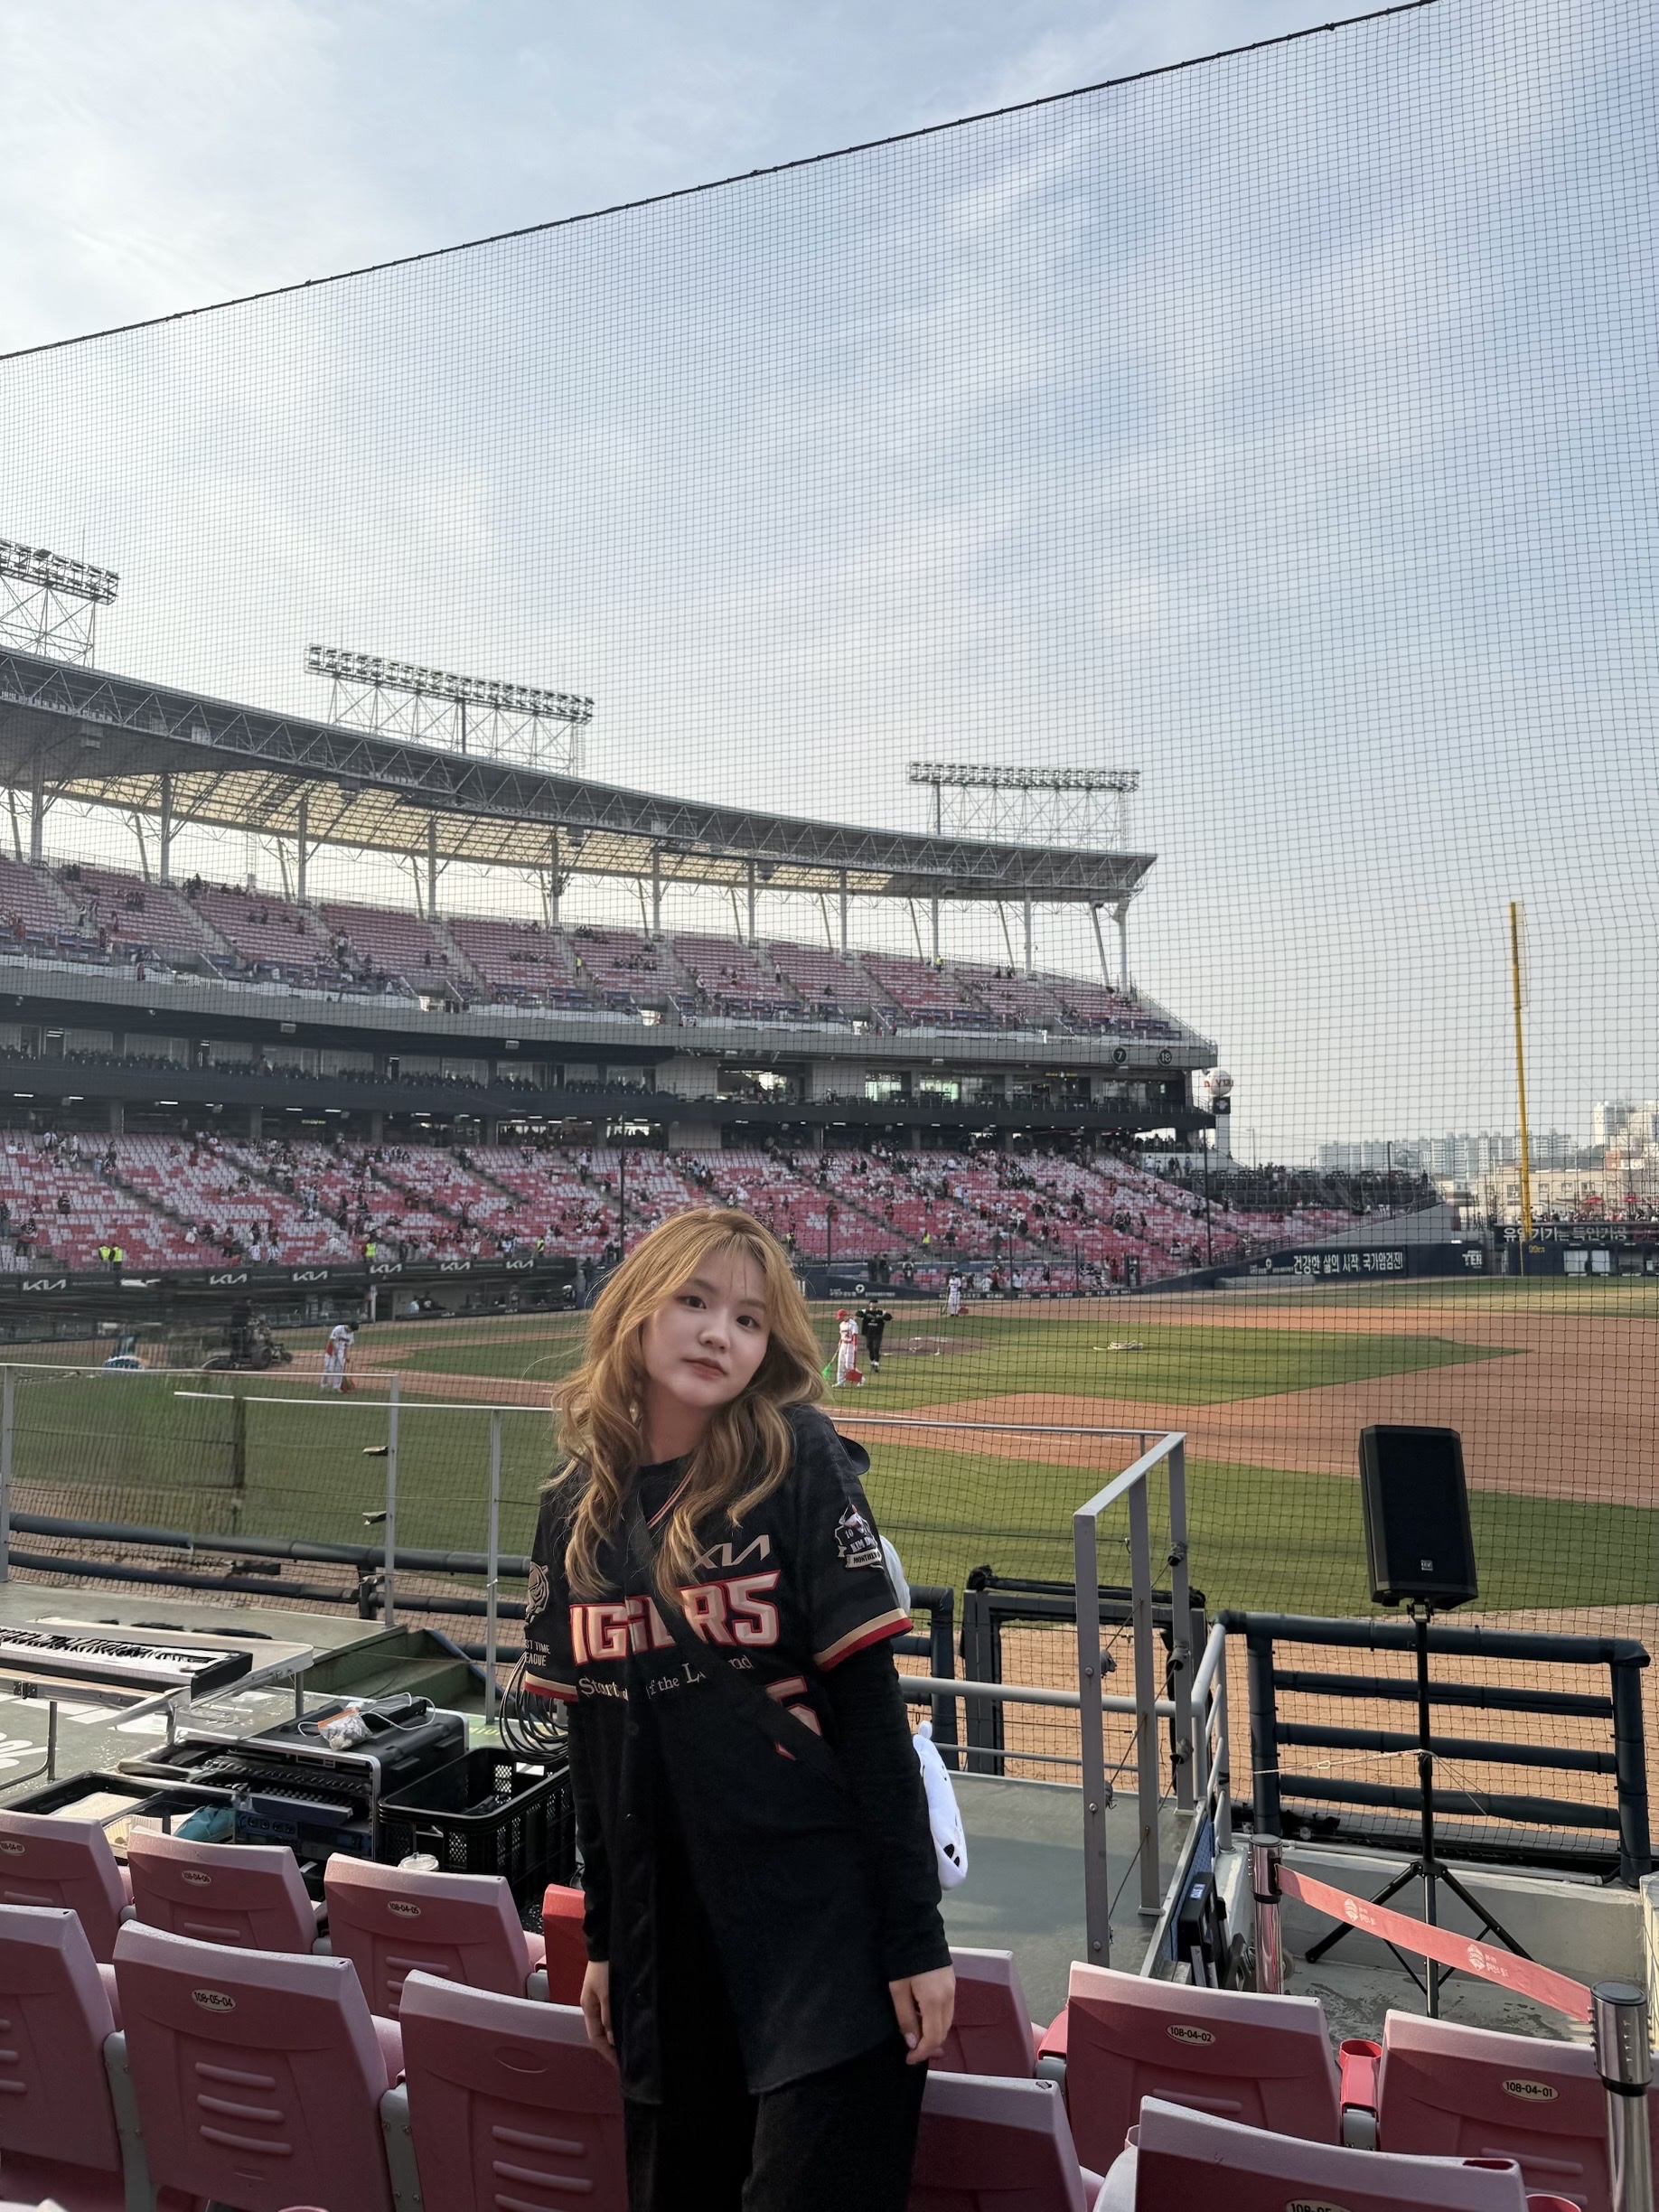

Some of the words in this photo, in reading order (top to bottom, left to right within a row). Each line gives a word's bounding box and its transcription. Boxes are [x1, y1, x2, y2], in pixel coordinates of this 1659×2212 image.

[1117, 1051, 1123, 1061] 7
[370, 1263, 402, 1274] KIA
[440, 1261, 471, 1272] KIA
[506, 1259, 534, 1270] KIA
[1293, 1254, 1320, 1275] 건강한
[1323, 1252, 1340, 1274] 삶의
[210, 1273, 248, 1285] KIA
[293, 1270, 328, 1281] KIA
[23, 1279, 66, 1290] KIA
[845, 1528, 854, 1539] 10
[850, 1539, 866, 1553] KIM
[535, 1641, 550, 1654] TIME
[578, 1675, 619, 1697] Start
[657, 1675, 680, 1692] the
[389, 1902, 419, 1915] 108-04-05
[193, 1992, 233, 2007] 108-05-04
[1170, 2027, 1213, 2042] 108-04-02
[1505, 2081, 1552, 2097] 108-04-01
